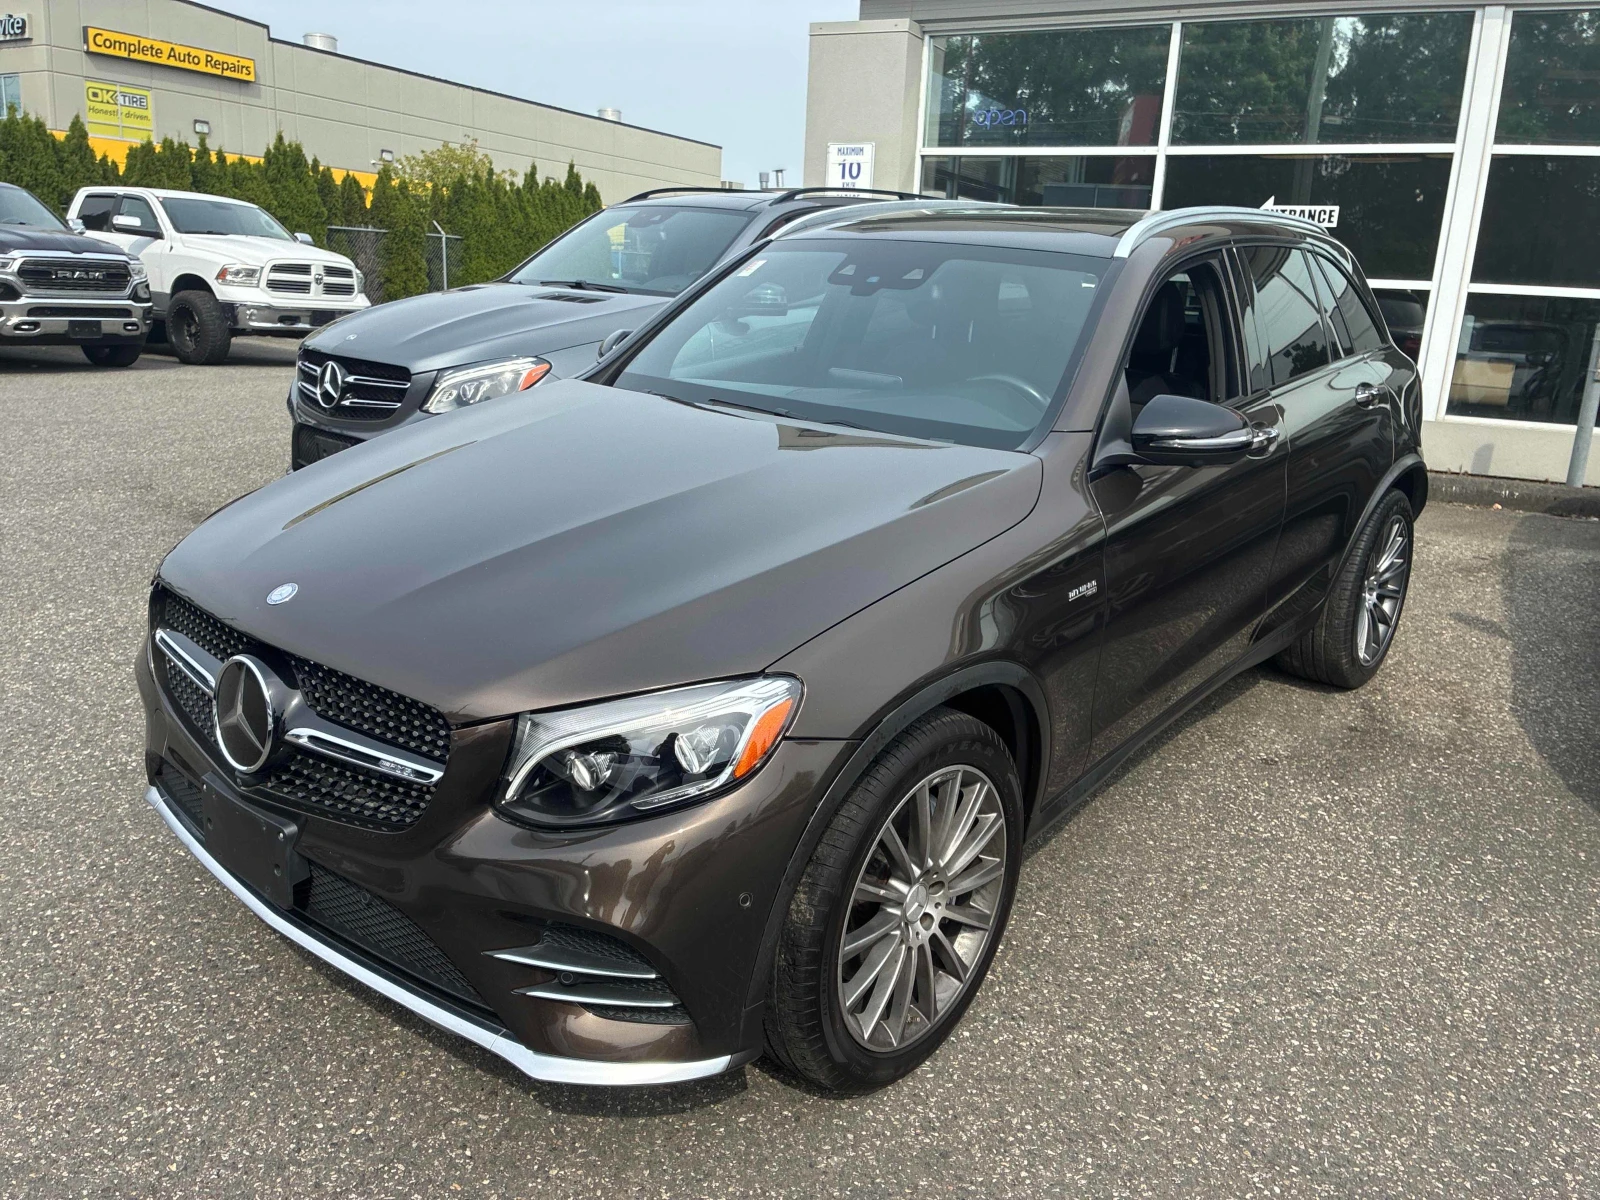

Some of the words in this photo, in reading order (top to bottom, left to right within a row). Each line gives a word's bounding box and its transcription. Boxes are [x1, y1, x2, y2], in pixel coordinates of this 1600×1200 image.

[93, 33, 163, 59] Complete
[167, 47, 201, 66] Auto
[205, 54, 251, 76] Repairs
[87, 87, 118, 105] OK
[120, 94, 146, 108] TIRE
[975, 109, 1027, 130] open
[837, 146, 864, 156] MAXIMUM
[838, 159, 862, 180] 10
[57, 270, 107, 279] RAM
